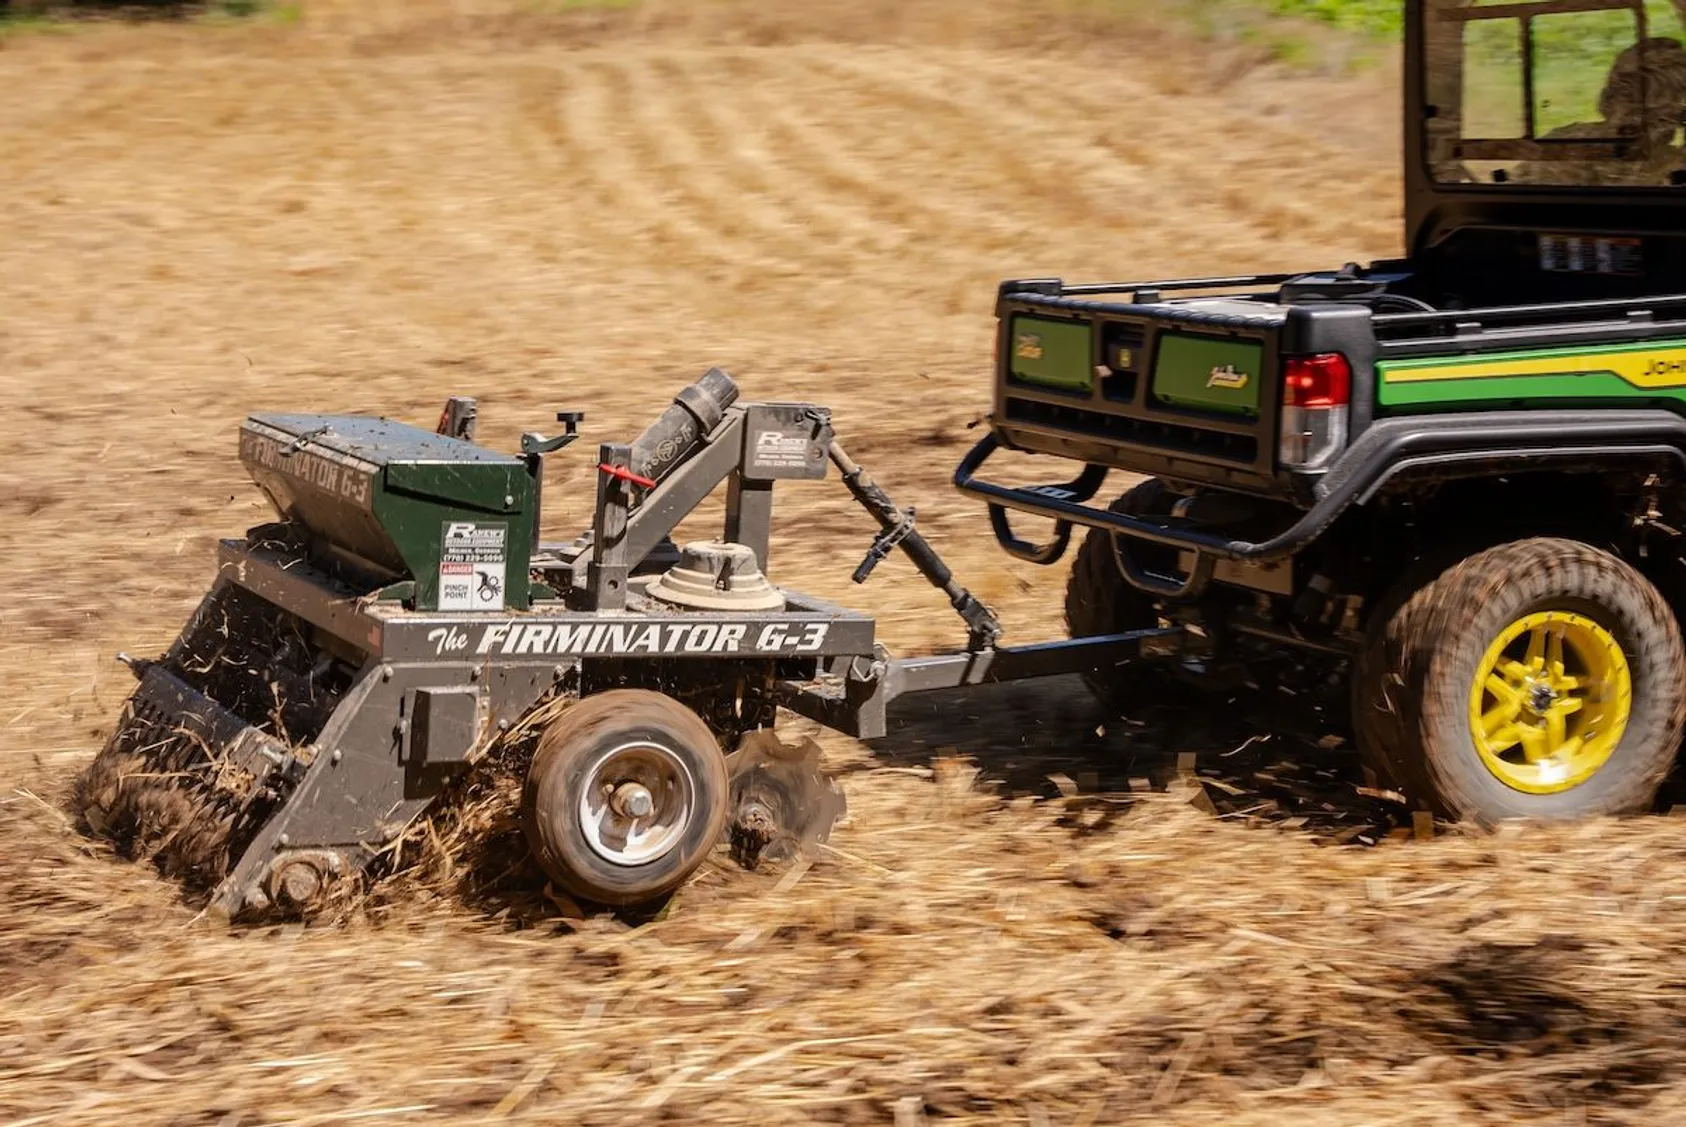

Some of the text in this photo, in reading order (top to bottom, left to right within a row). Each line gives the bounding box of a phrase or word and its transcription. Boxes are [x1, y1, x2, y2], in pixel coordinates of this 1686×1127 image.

[341, 469, 369, 503] G-3
[444, 584, 469, 592] PINCH
[427, 623, 829, 655] The FIRMINATOR G-3
